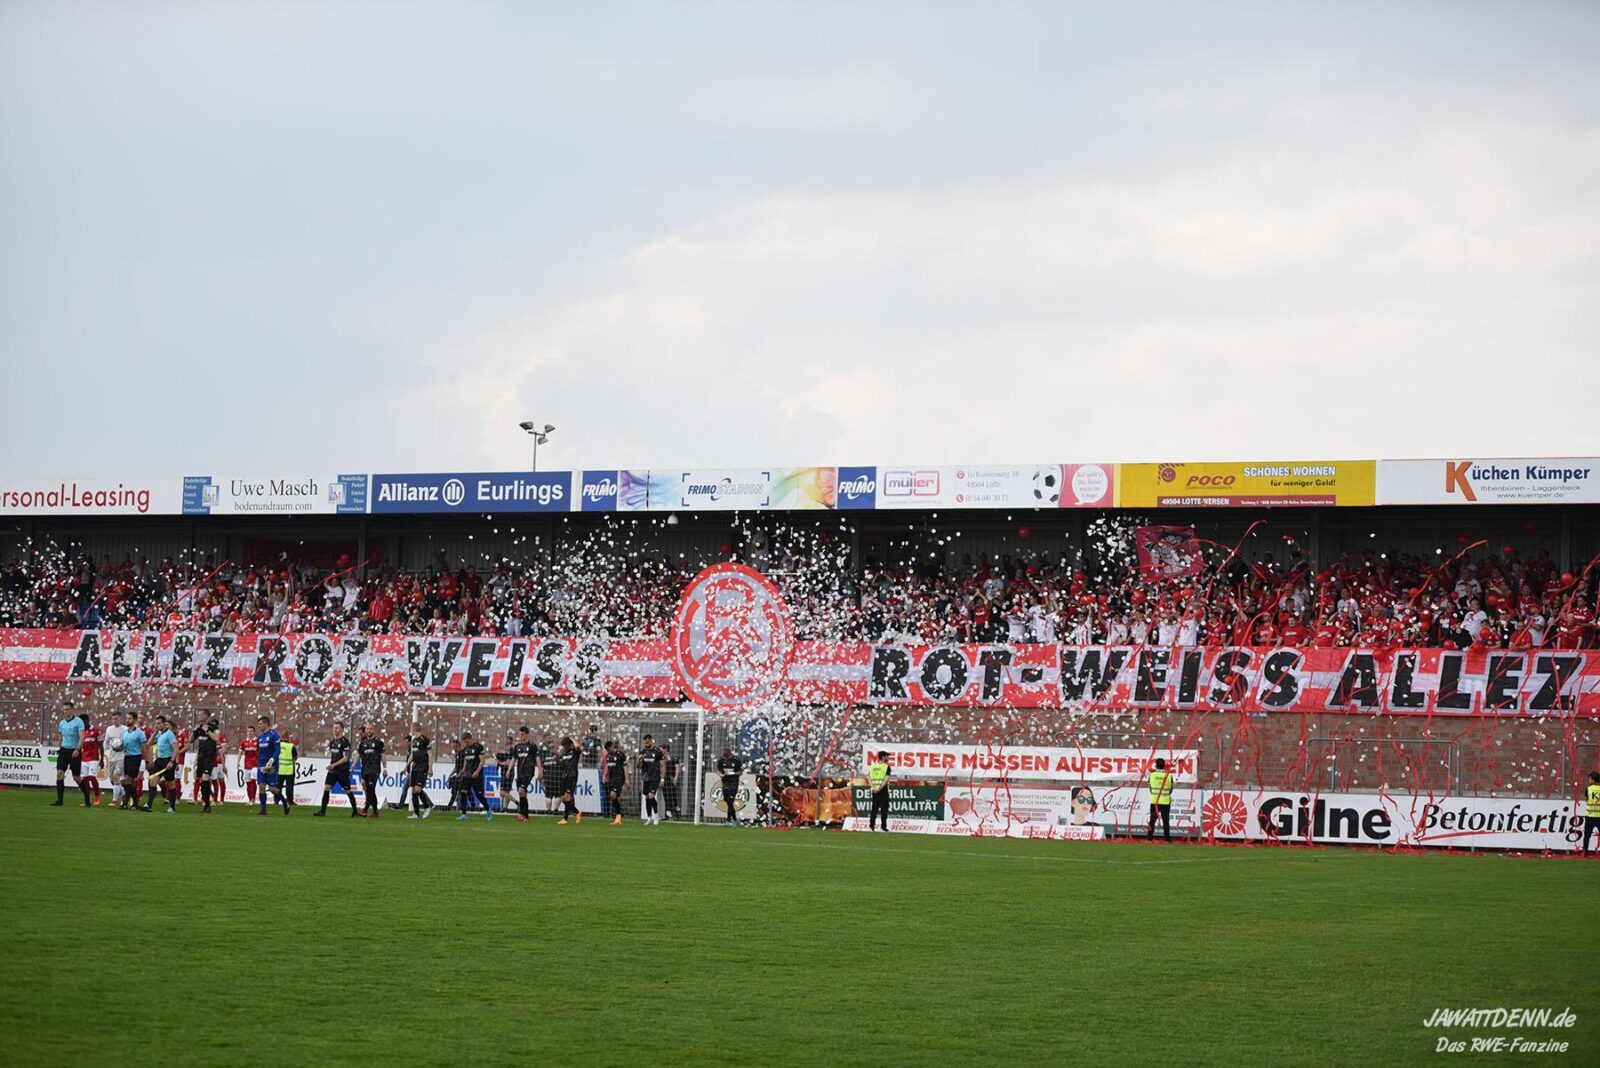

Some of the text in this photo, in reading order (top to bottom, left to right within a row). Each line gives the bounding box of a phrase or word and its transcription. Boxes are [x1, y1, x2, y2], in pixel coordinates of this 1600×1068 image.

[1244, 465, 1337, 477] SCHÖNES WOHNEN
[888, 477, 935, 489] müller
[1187, 475, 1236, 486] POCO
[1271, 479, 1336, 488] für weniger Geld!
[1446, 461, 1591, 501] Küchen Kümper
[231, 479, 318, 496] Uwe Masch
[378, 480, 564, 505] Allianz Eurlings
[583, 482, 617, 499] FRIMO
[688, 484, 717, 495] FRIMO
[838, 478, 876, 496] FRIMO
[1532, 484, 1581, 493] Laggenbeck
[0, 483, 150, 513] rsonal-Leasing
[1182, 497, 1230, 505] LOTTE-WERSEN
[234, 501, 312, 512] bodenundraum.com
[867, 644, 1587, 715] ROT-WEISS ALLEZ
[0, 746, 42, 759] RISHA
[867, 751, 955, 769] MEISTER
[961, 753, 1050, 772] MÜSSEN
[856, 789, 872, 799] DE
[1258, 797, 1392, 841] Gilne
[890, 824, 925, 832] BECKHOFF
[936, 826, 970, 834] BECKHOFF
